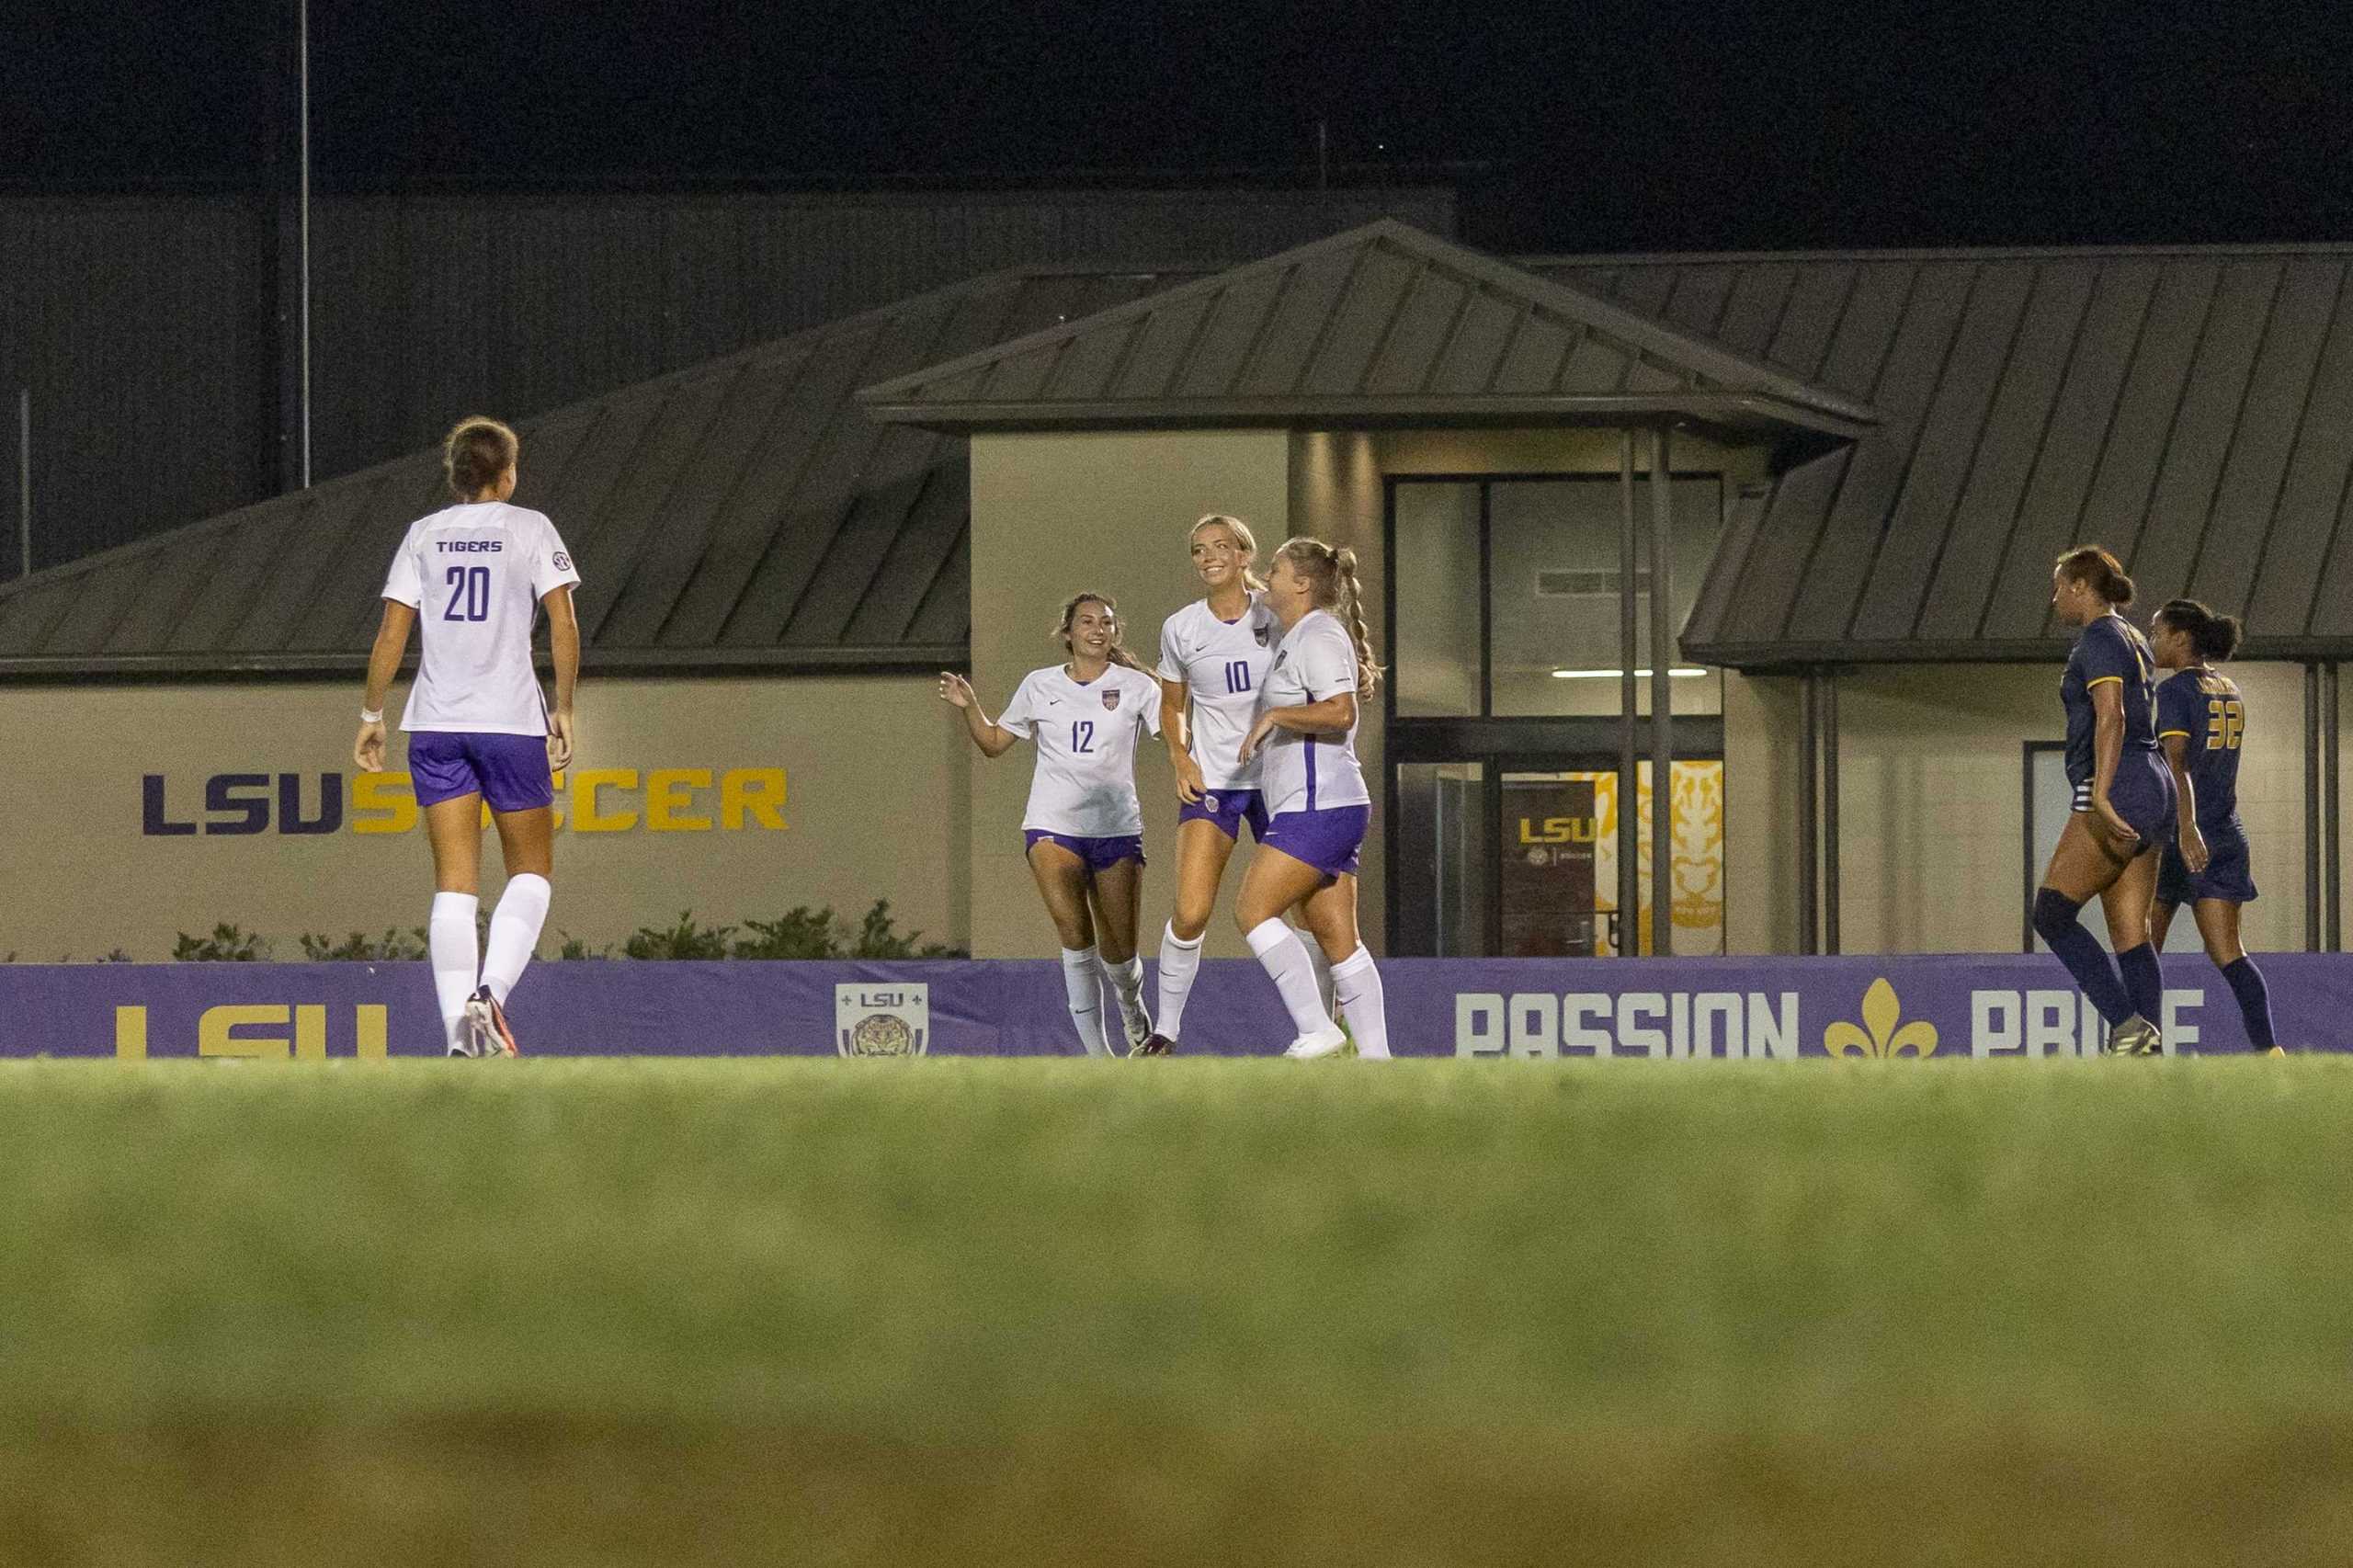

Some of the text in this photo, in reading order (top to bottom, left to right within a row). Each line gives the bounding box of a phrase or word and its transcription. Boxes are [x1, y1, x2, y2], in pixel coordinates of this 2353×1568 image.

[436, 540, 503, 552] TIGERS
[444, 565, 490, 621] 20
[1224, 660, 1251, 694] 10
[1072, 721, 1094, 753] 12
[2207, 699, 2244, 750] 32
[1520, 818, 1597, 843] LSU
[860, 993, 904, 1007] LSU
[1456, 989, 2204, 1059] PASSION PRIE
